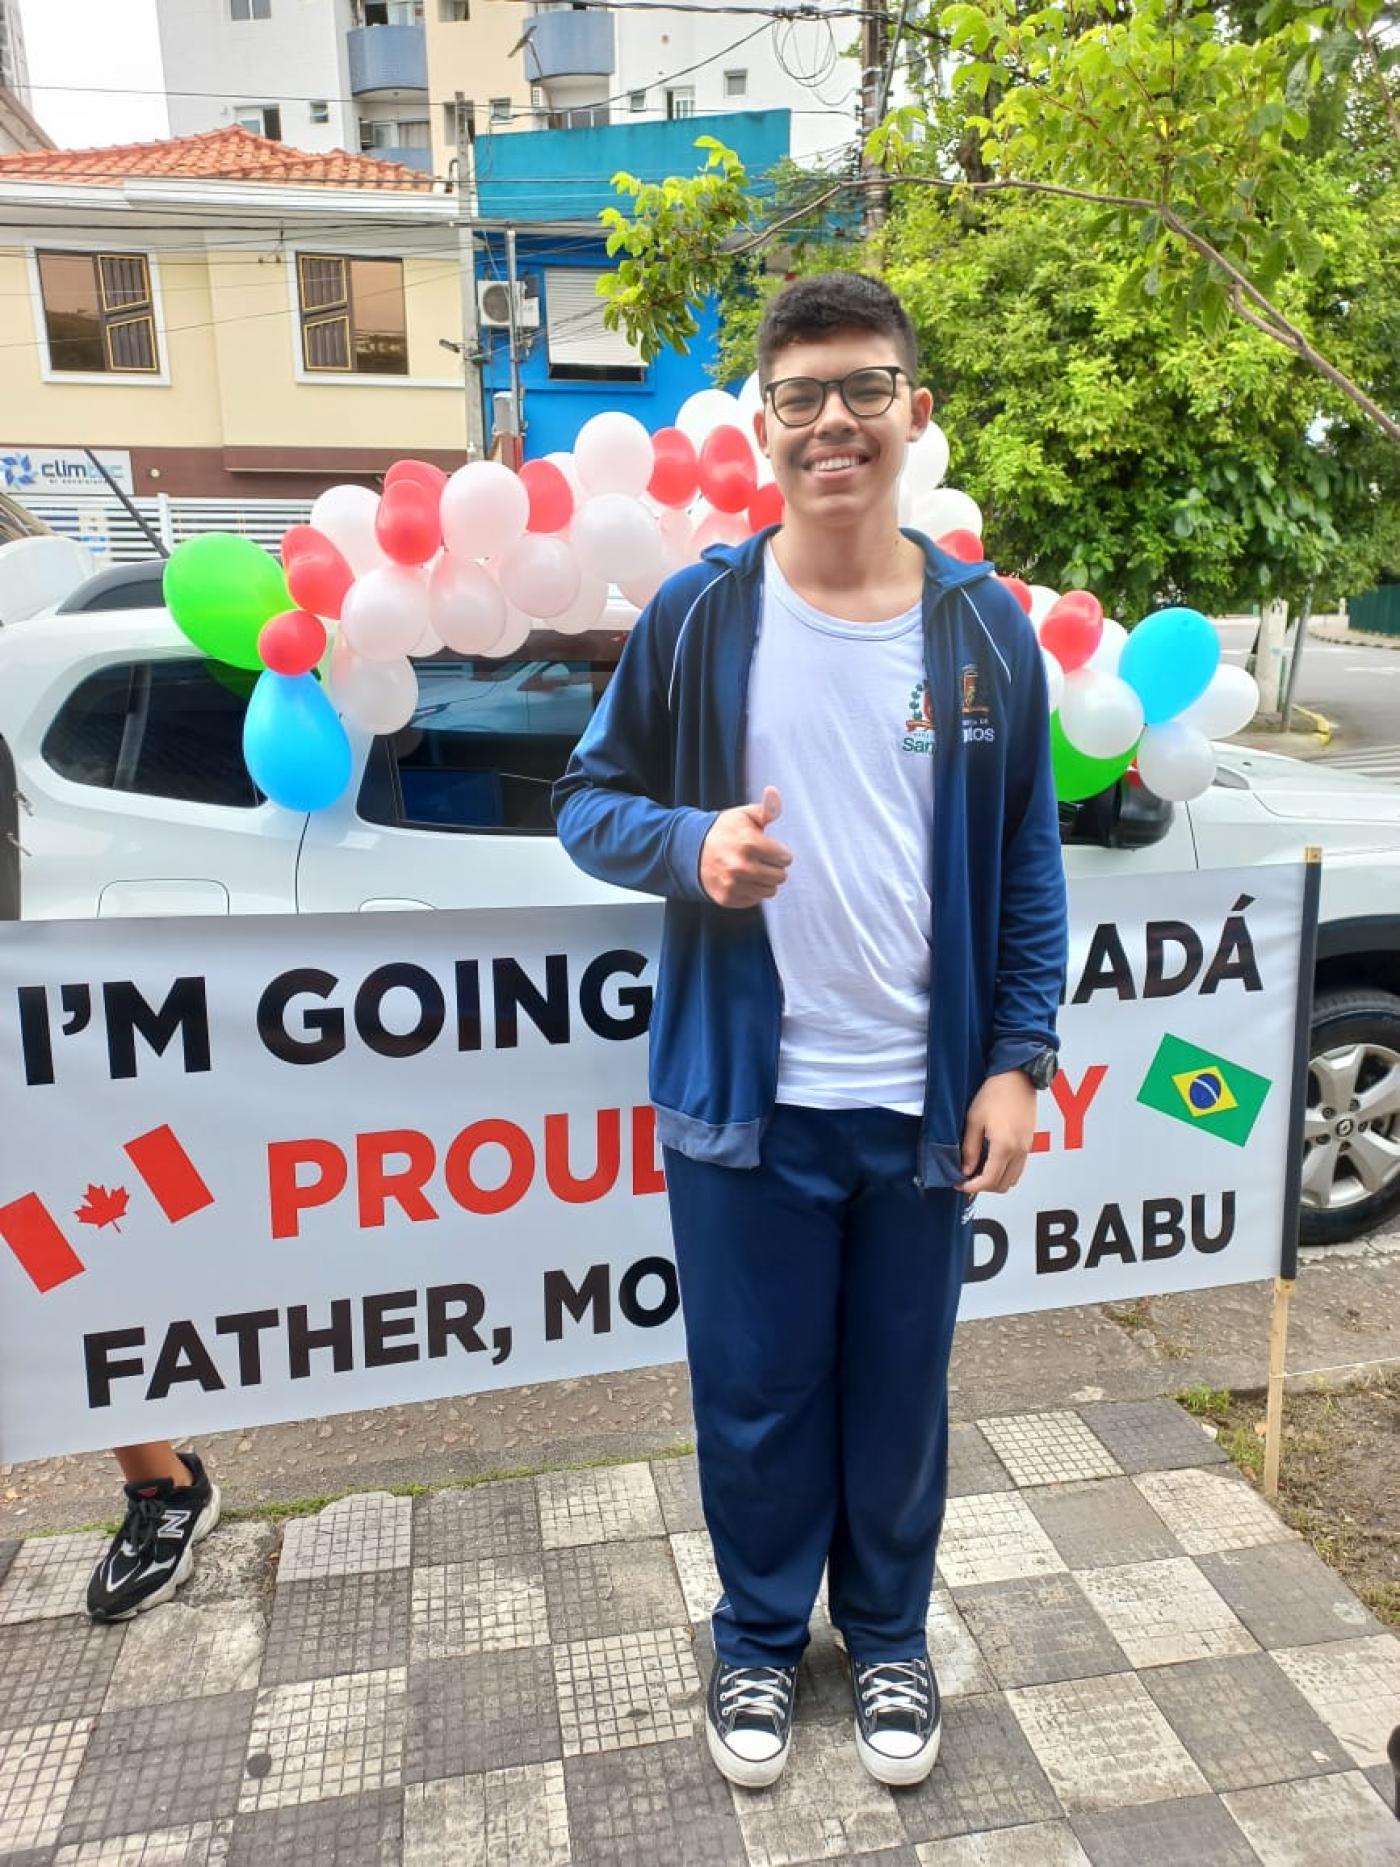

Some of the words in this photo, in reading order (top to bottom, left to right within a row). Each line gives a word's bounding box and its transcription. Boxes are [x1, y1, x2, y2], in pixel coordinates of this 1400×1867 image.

[17, 975, 211, 1086] I'M
[256, 949, 653, 1065] GOING
[1059, 893, 1264, 1006] ADÁ
[83, 1282, 513, 1409] FATHER,
[1035, 1191, 1236, 1275] BABU
